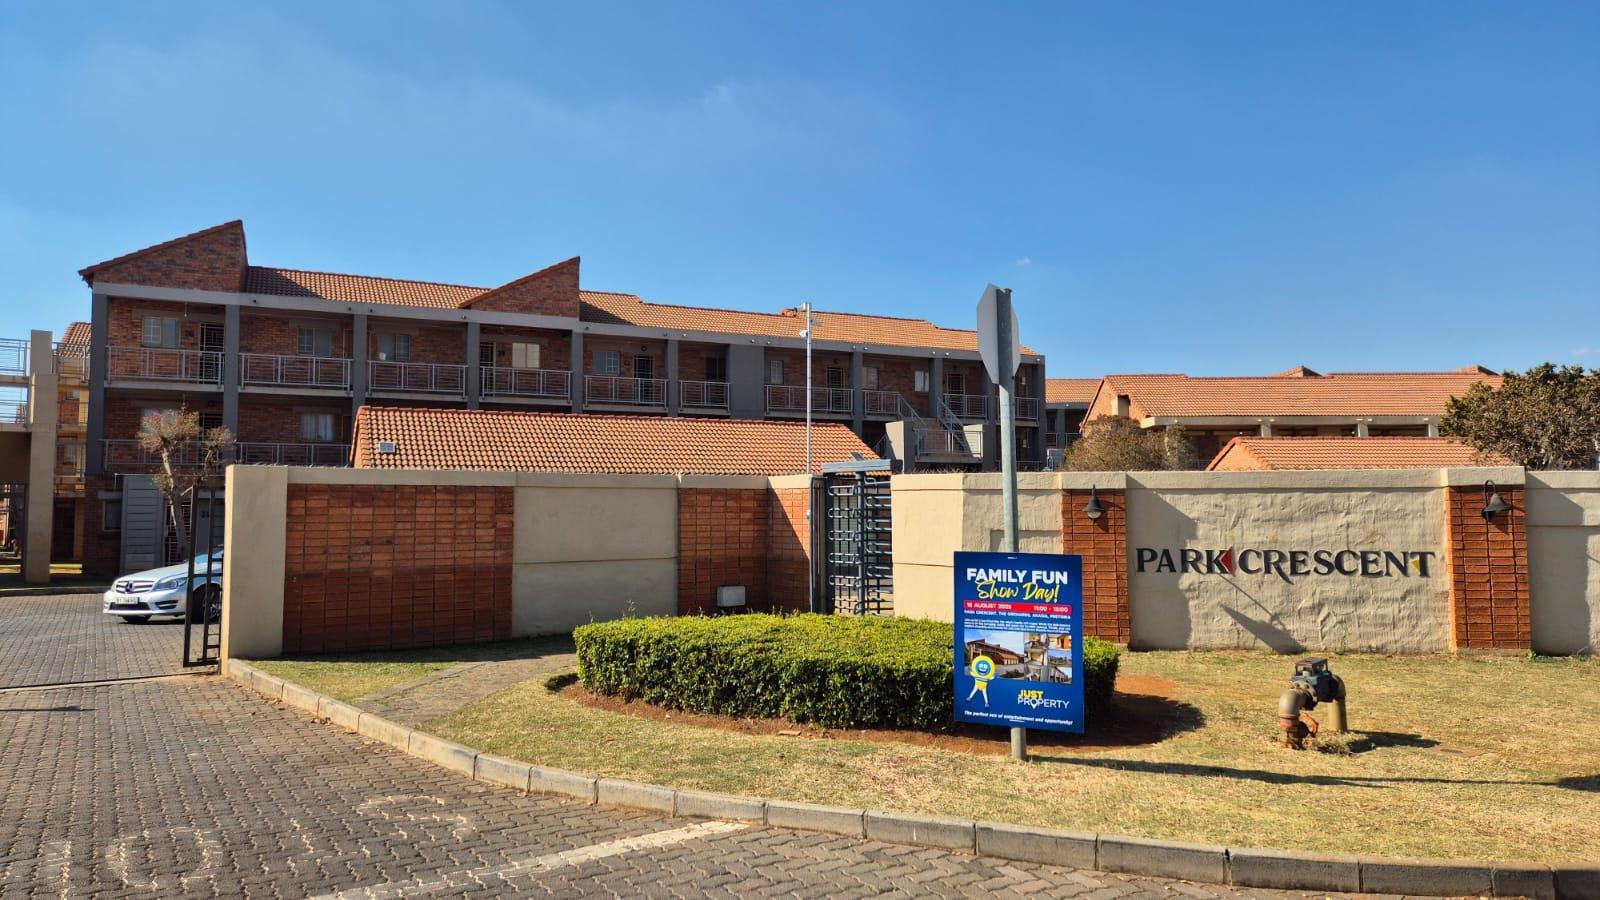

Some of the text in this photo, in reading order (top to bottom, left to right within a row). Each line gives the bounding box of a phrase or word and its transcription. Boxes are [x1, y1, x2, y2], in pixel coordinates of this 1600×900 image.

[1135, 547, 1436, 585] PARK CRESCENT
[966, 568, 1068, 585] FAMILY FUN
[975, 579, 1060, 603] Show Day!
[974, 601, 997, 609] AUGUST
[1018, 689, 1044, 699] JUST
[1017, 697, 1070, 709] PROPERTY
